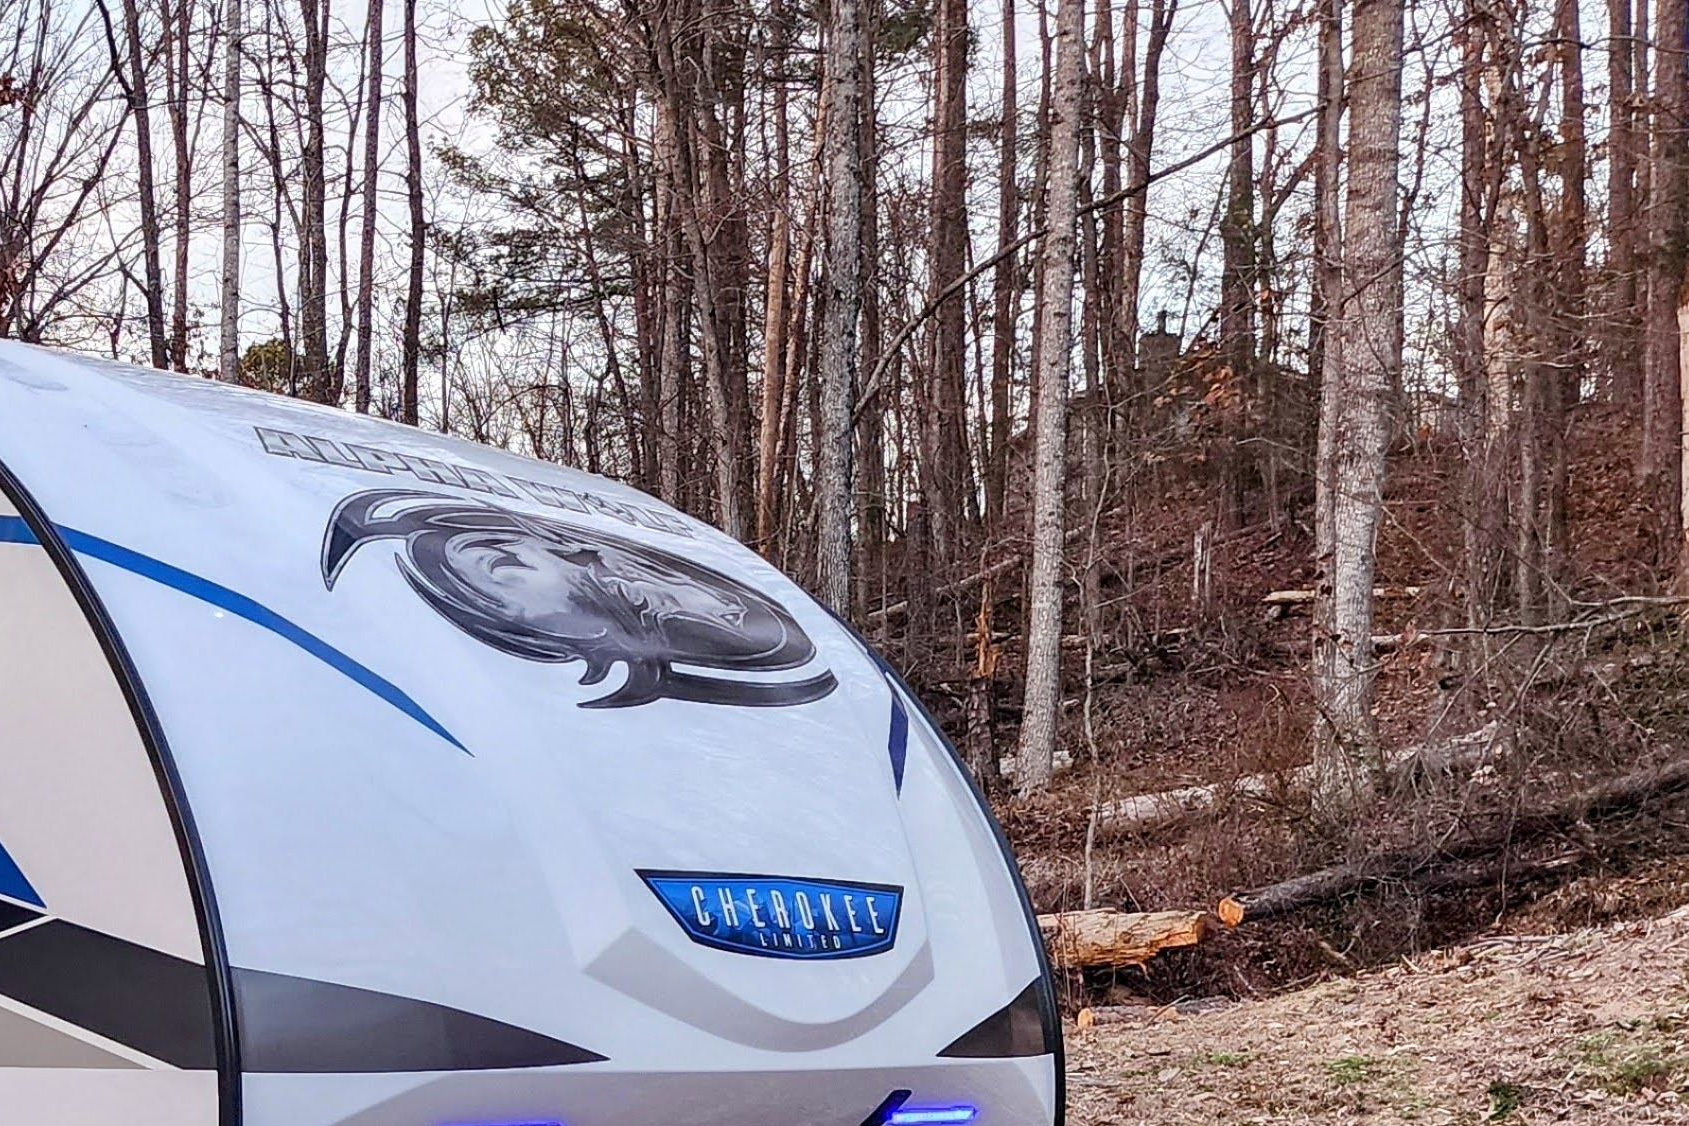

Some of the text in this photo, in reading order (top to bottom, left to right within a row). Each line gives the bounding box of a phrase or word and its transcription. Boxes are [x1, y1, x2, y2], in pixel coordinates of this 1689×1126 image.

[253, 426, 523, 499] ALPHA
[691, 885, 884, 934] CHEROKEE
[760, 932, 841, 949] LIMITED
